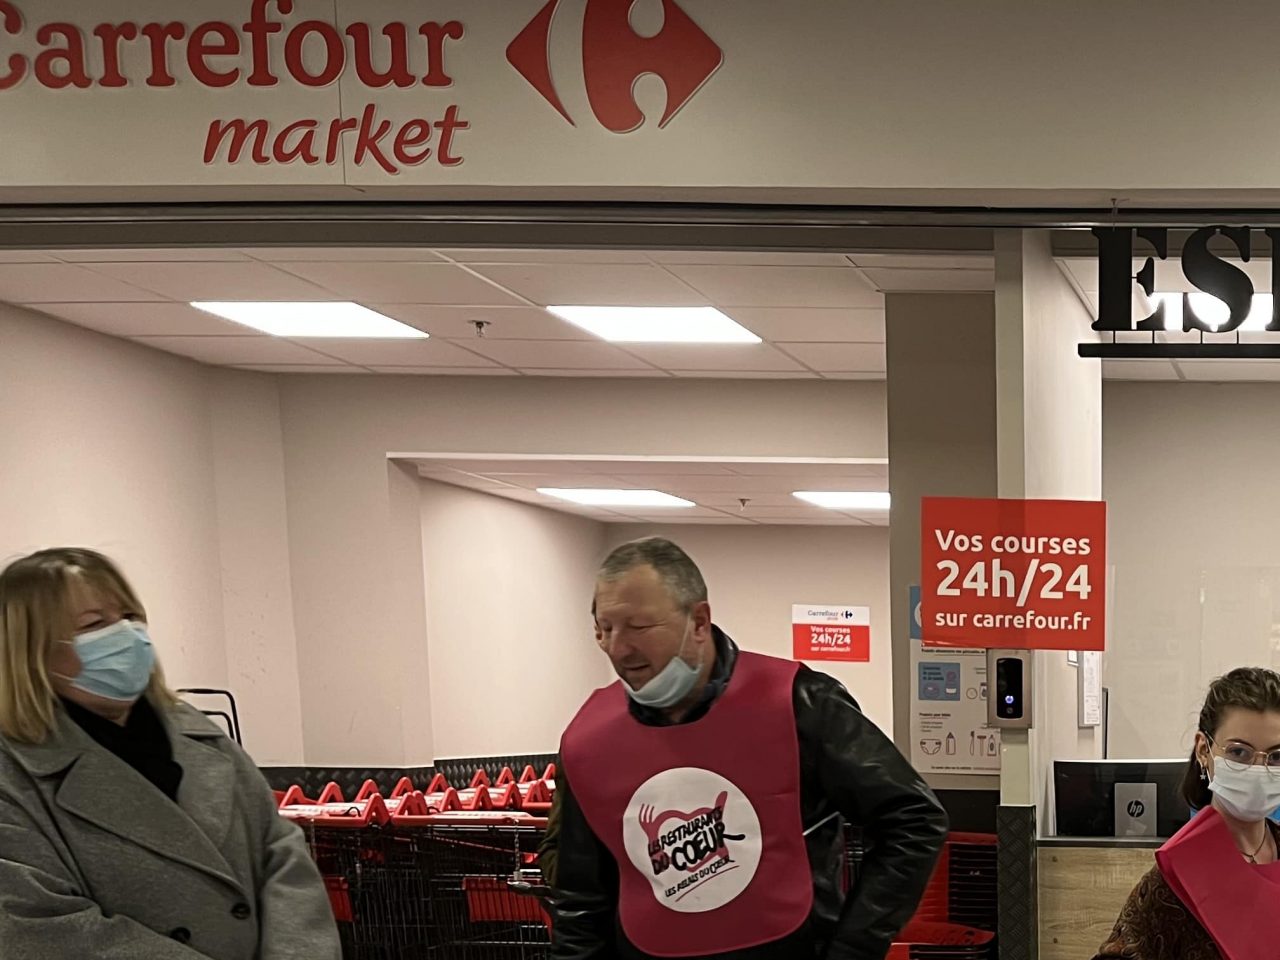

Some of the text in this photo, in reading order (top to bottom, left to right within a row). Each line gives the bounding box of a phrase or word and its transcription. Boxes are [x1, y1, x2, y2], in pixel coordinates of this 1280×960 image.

[204, 104, 469, 174] market
[935, 529, 1090, 555] Vos courses
[936, 559, 1091, 607] 24h/24
[936, 611, 1090, 630] sur carrefour.fr
[811, 633, 850, 646] 24h/24
[1128, 801, 1142, 817] hp
[665, 887, 676, 897] LES
